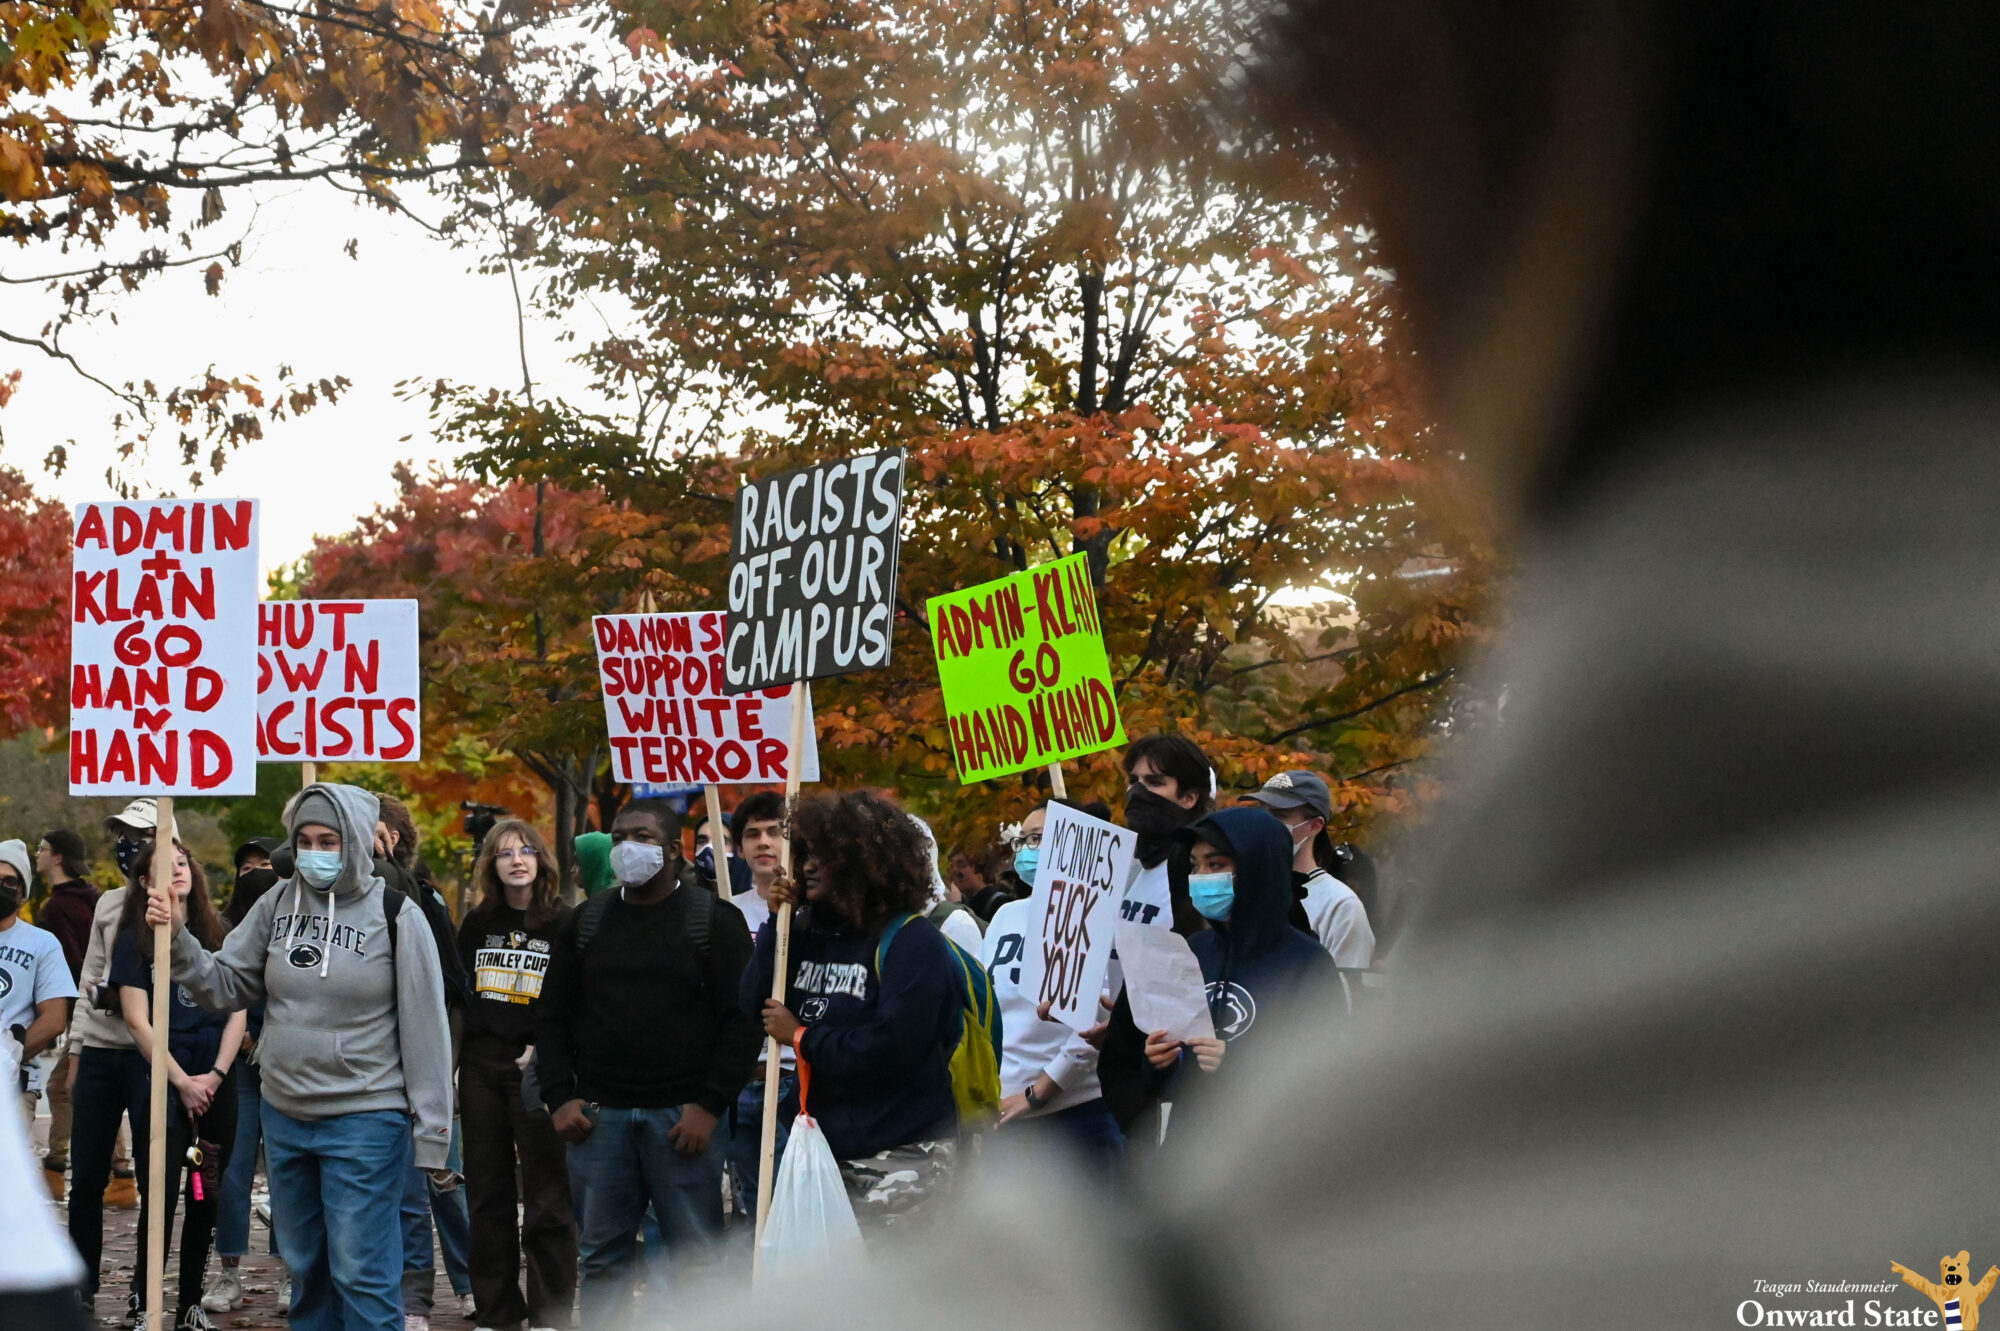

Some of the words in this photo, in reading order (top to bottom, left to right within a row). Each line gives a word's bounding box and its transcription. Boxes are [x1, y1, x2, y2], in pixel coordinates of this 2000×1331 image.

[75, 501, 251, 555] ADMIN
[740, 455, 900, 555] RACISTS
[74, 567, 215, 625] KLAN
[729, 546, 791, 618] OFF
[800, 534, 885, 603] OUR
[114, 620, 202, 667] GO
[595, 616, 693, 656] DAMON
[726, 602, 888, 686] CAMPUS
[71, 664, 224, 712] HAND
[1009, 642, 1060, 694] GO
[617, 697, 763, 742] WHITE
[950, 704, 1029, 777] HAND
[1048, 676, 1116, 753] HAND
[70, 729, 233, 789] HAND
[610, 737, 788, 783] TERROR
[272, 914, 311, 942] ENN
[312, 915, 366, 957] STATE
[1043, 879, 1098, 952] FUCK
[477, 952, 522, 968] STANLEY
[524, 954, 549, 972] CUP
[1039, 940, 1086, 1012] YOU!
